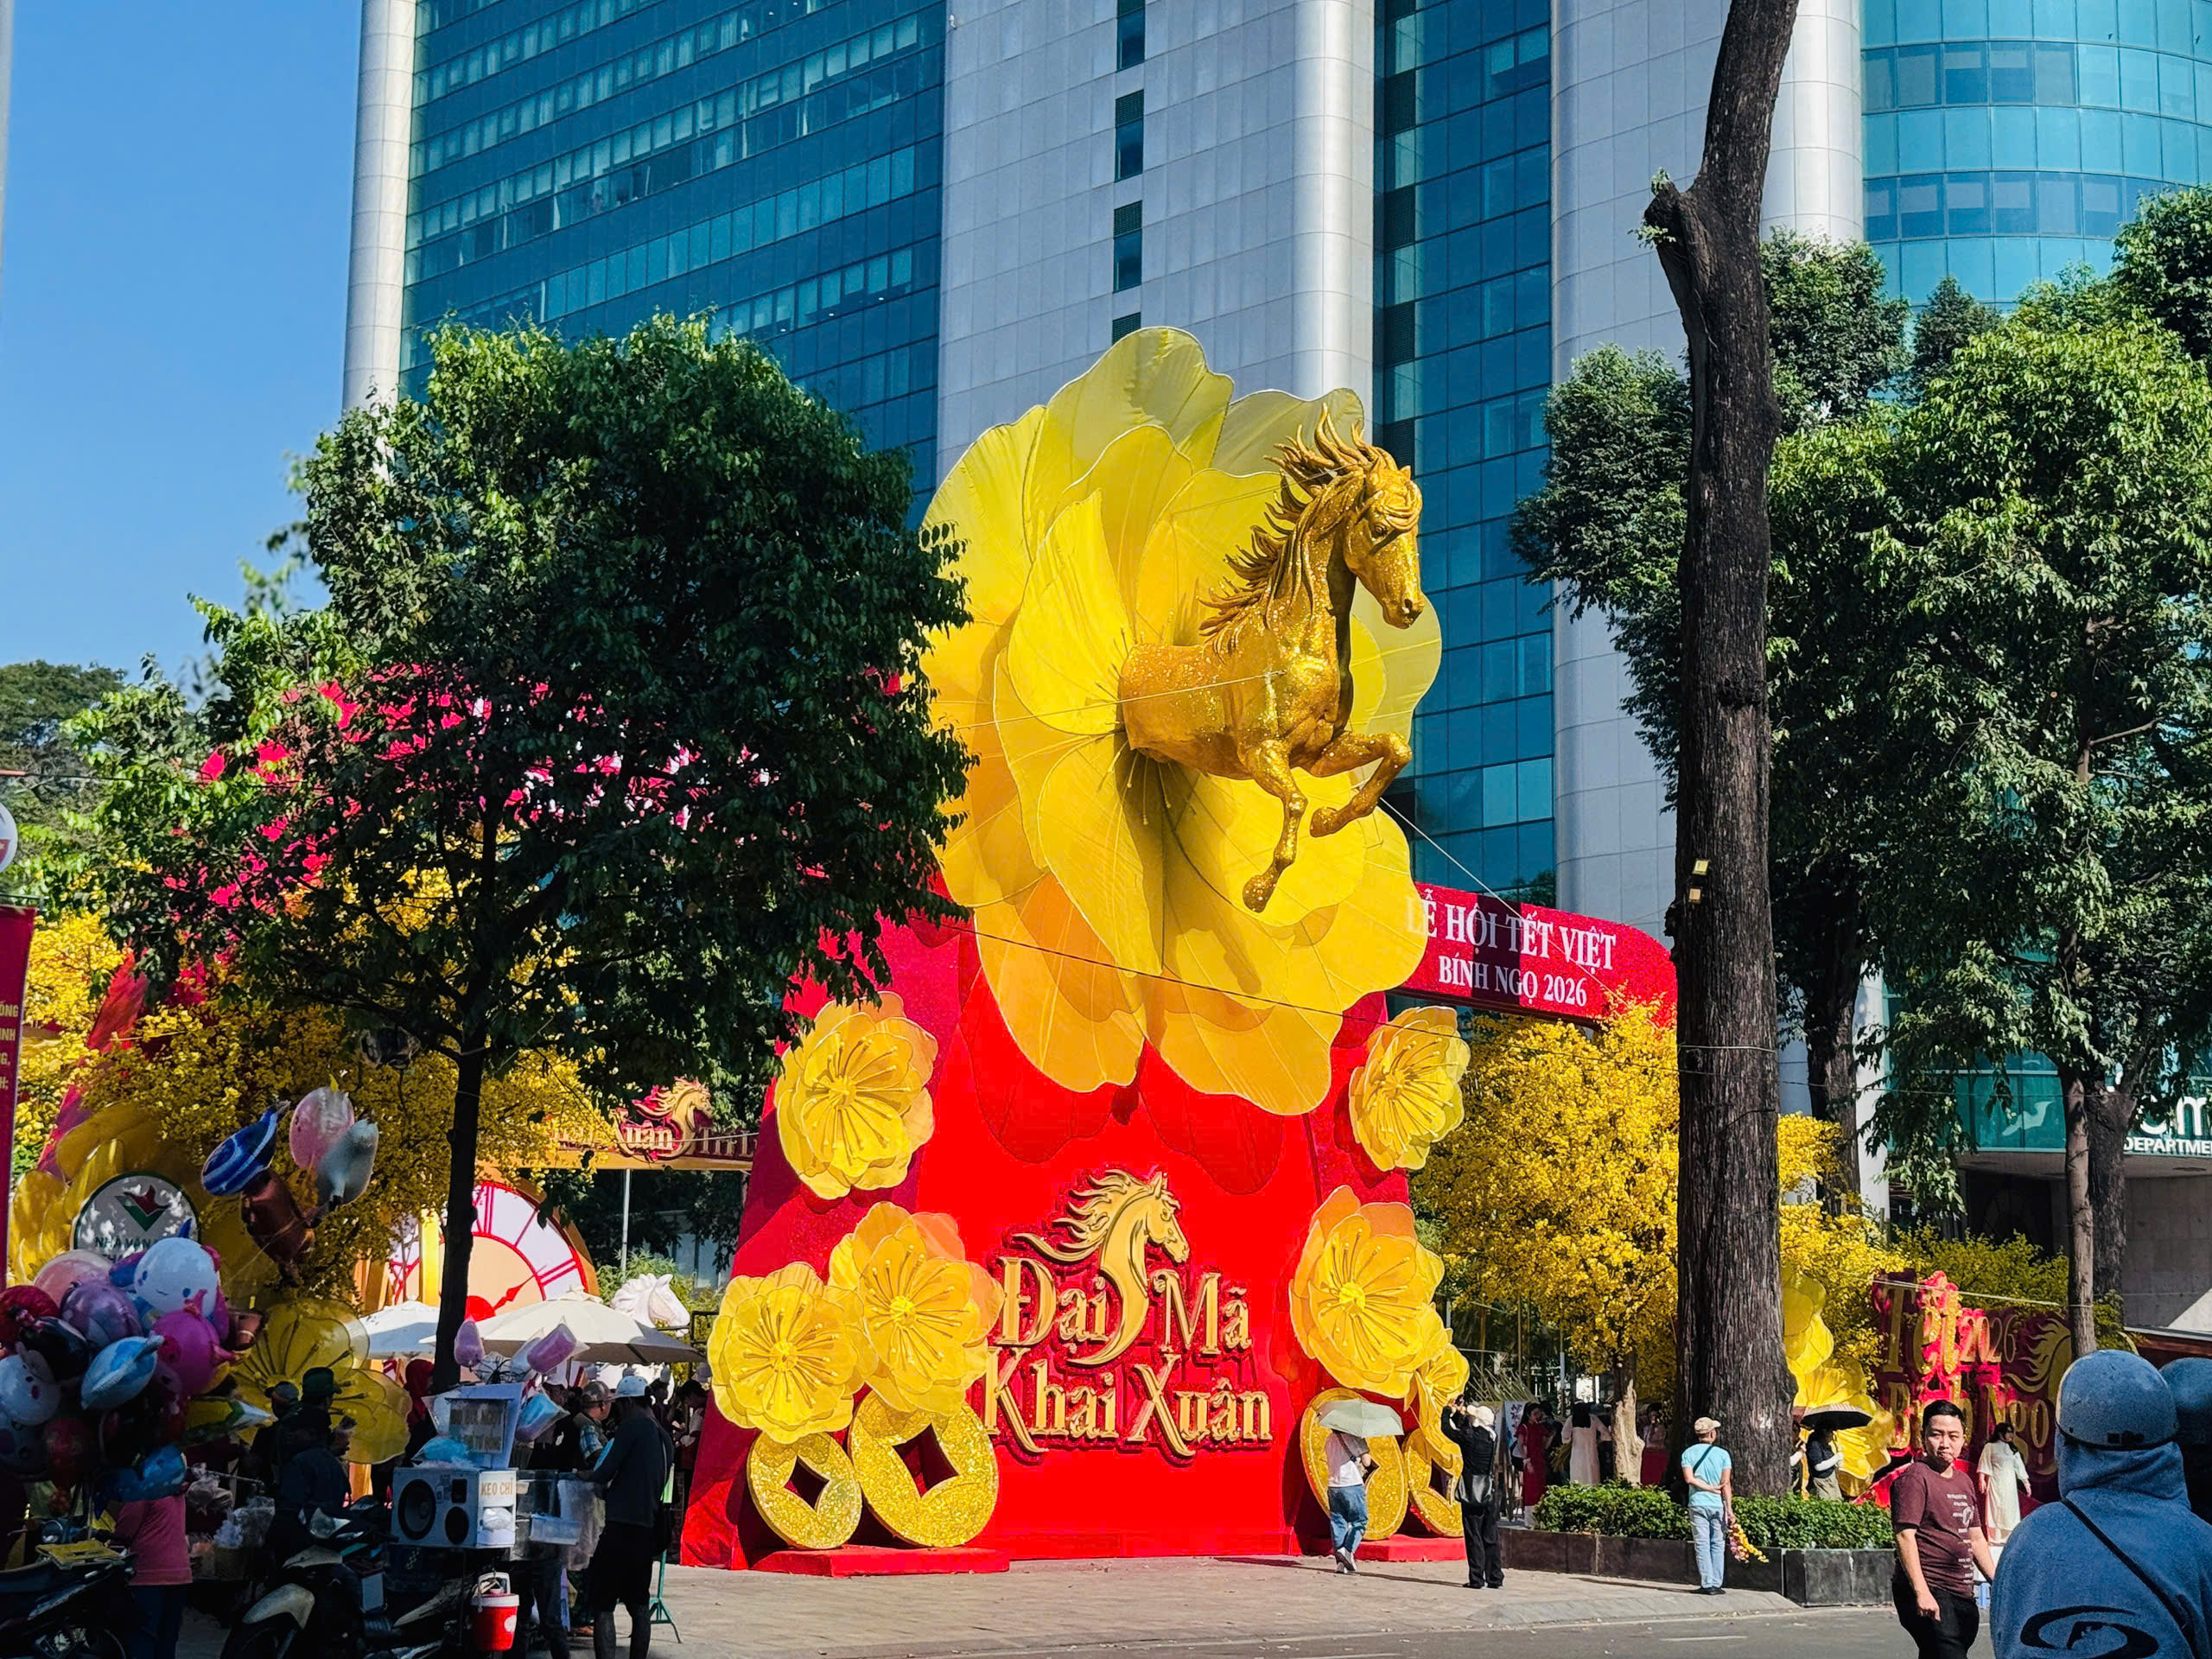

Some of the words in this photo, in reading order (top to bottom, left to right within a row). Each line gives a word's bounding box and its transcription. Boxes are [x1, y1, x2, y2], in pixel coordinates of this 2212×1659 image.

[1445, 903, 1497, 954] HỘI
[1506, 911, 1554, 958] TẾT
[1559, 925, 1616, 974] VIỆT
[1439, 951, 1489, 990] BÍNH
[1495, 965, 1538, 1002] NGỌ
[1543, 974, 1586, 1007] 2026
[997, 1256, 1110, 1354] Đại
[1150, 1269, 1252, 1356] Mã
[1960, 1313, 2019, 1364] 2026
[983, 1346, 1118, 1453] Khai
[1124, 1354, 1273, 1457] Xuân
